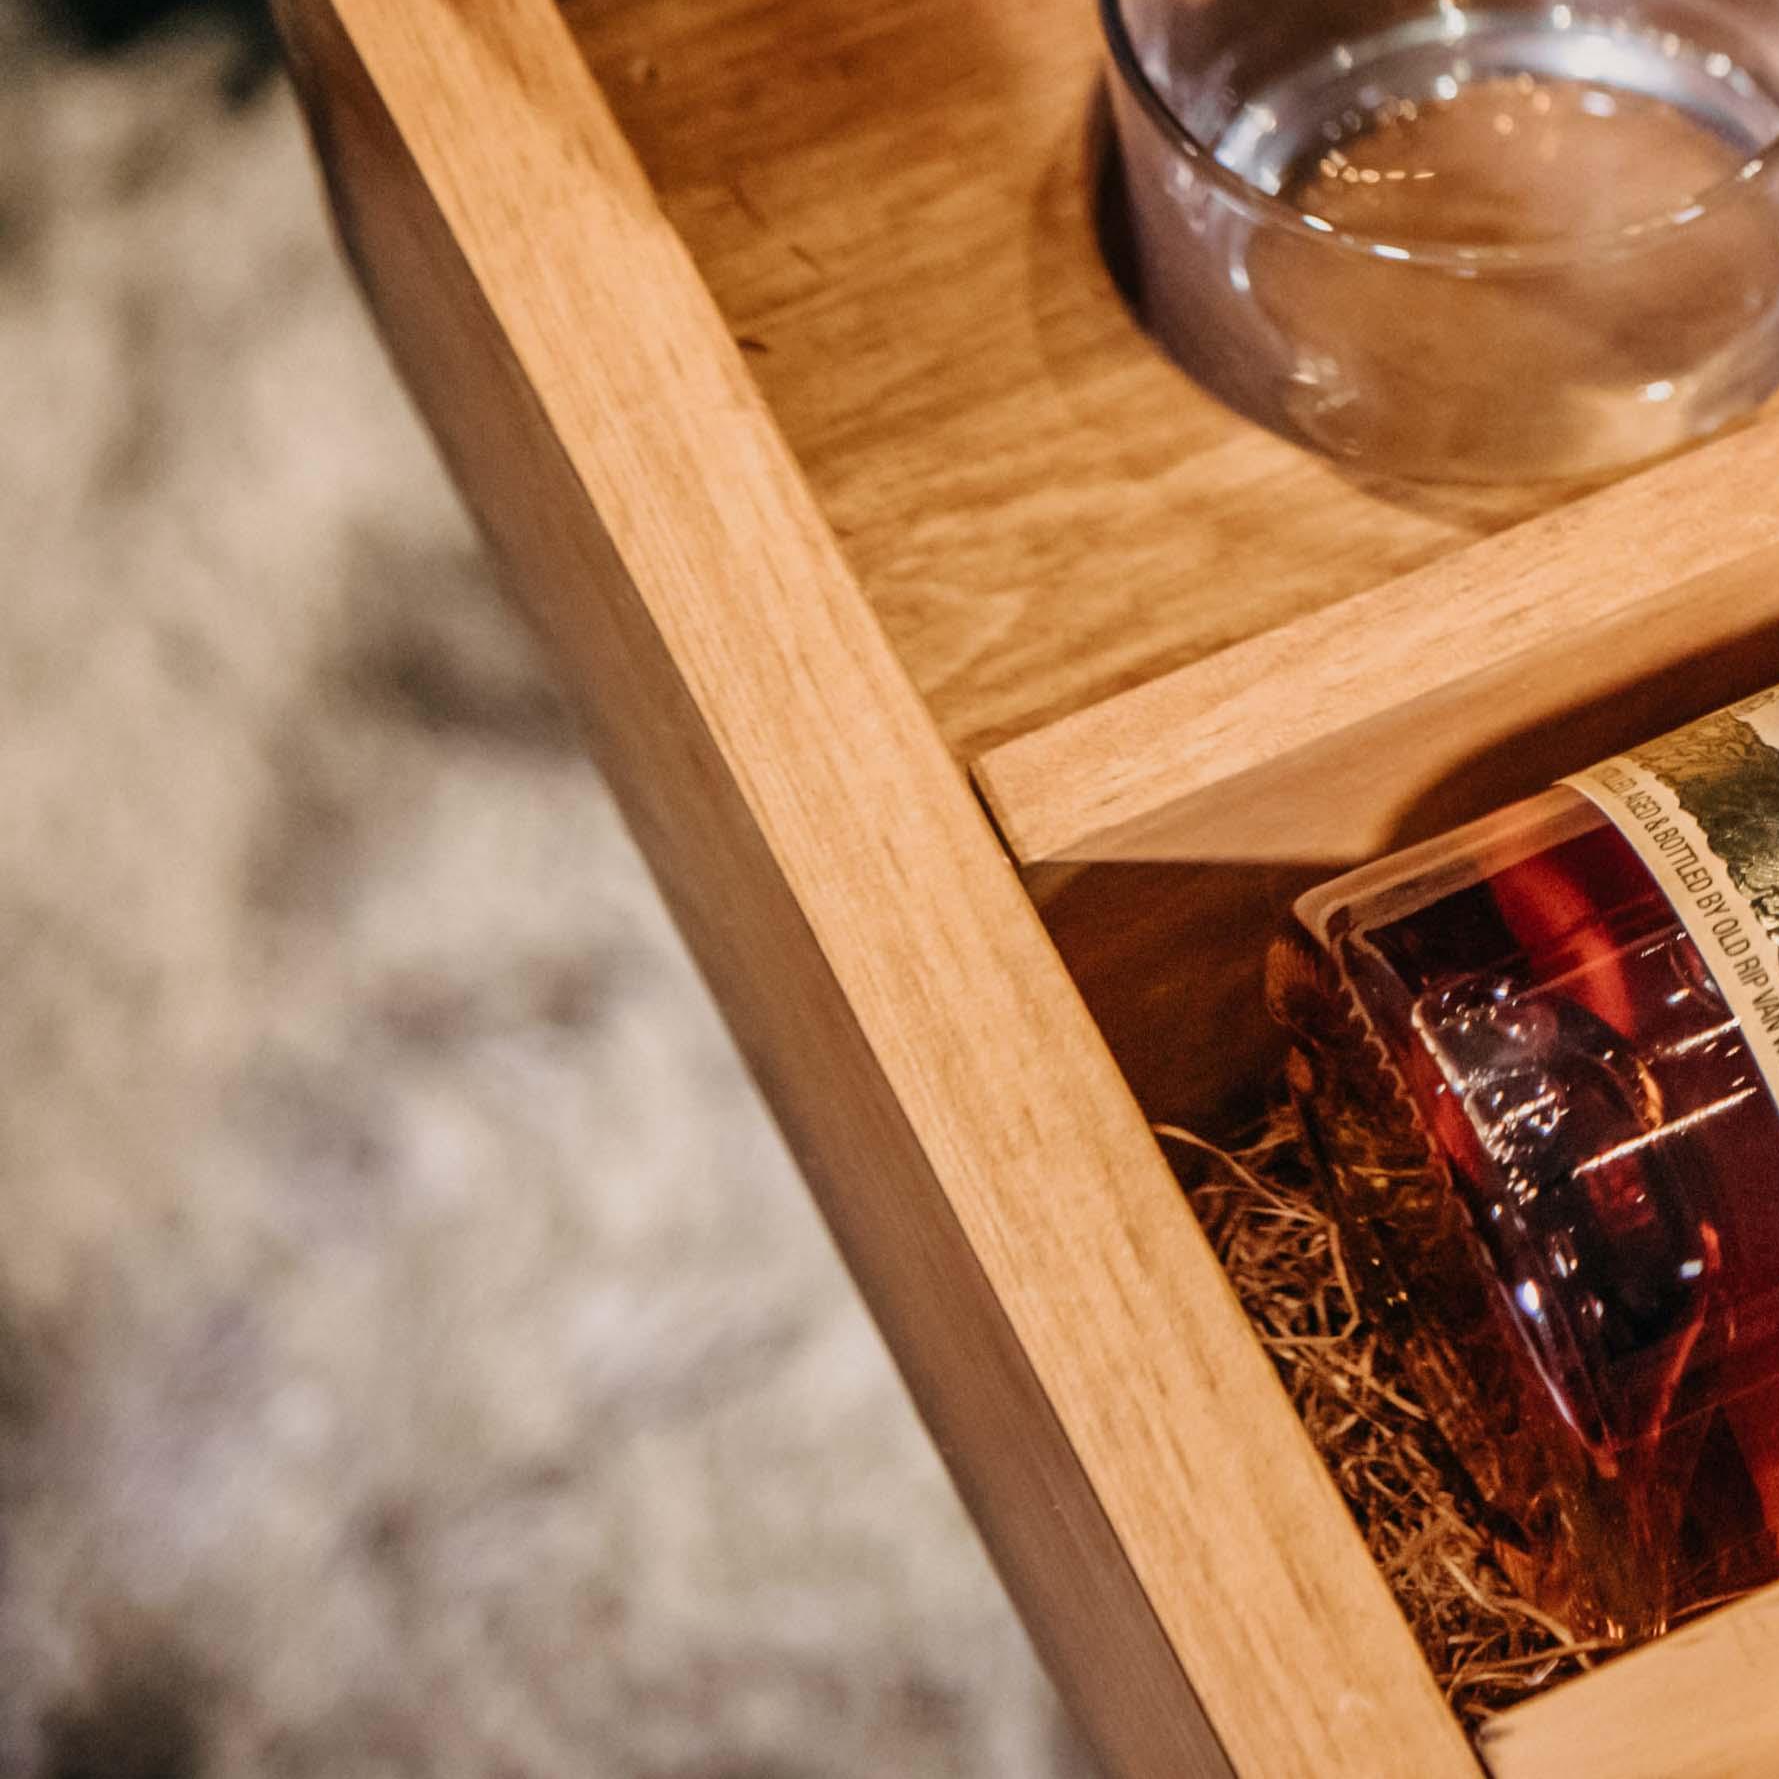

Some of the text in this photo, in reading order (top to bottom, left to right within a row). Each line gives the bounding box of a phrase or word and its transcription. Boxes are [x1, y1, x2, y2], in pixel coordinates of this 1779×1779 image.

[1624, 789, 1663, 822] AGED
[1644, 816, 1671, 833] &
[1652, 827, 1714, 894] BOTTLED
[1695, 891, 1730, 920] BY
[1712, 919, 1751, 958] OLD
[1733, 954, 1770, 988] RIP
